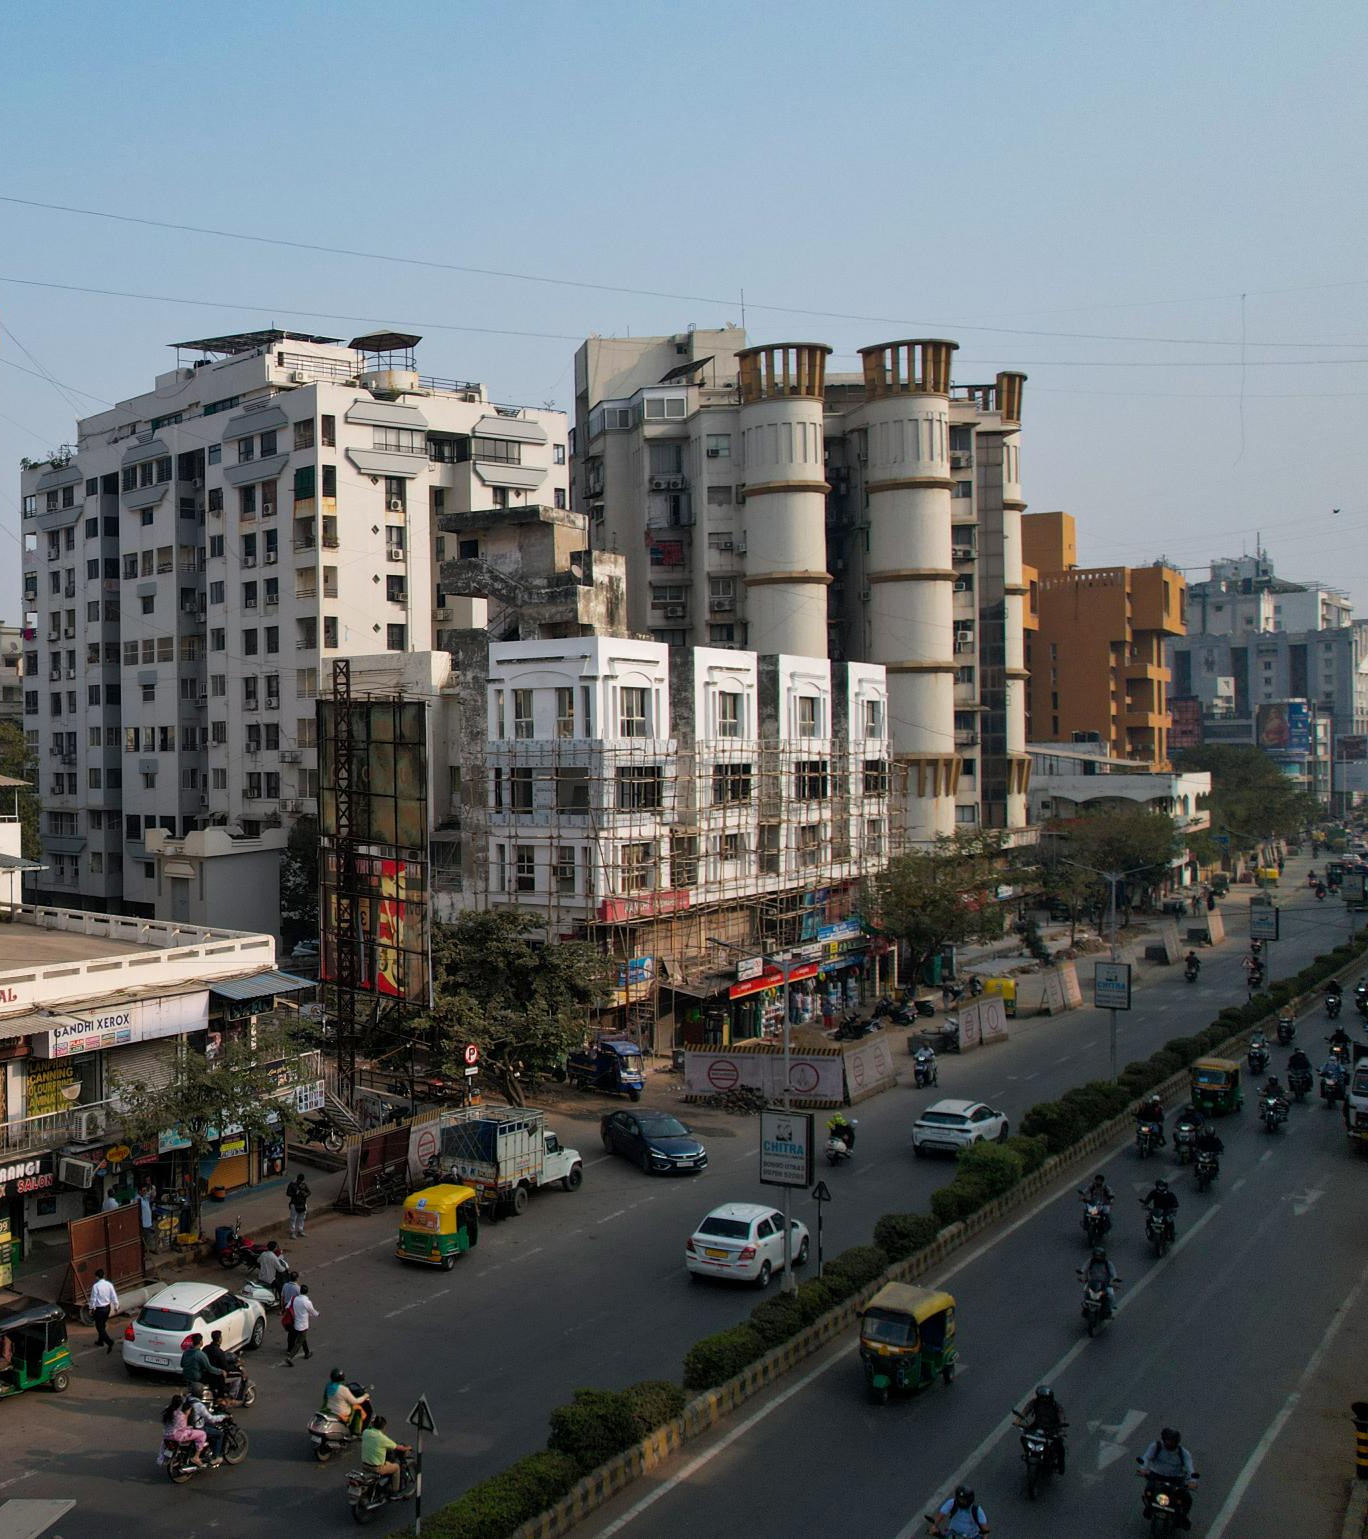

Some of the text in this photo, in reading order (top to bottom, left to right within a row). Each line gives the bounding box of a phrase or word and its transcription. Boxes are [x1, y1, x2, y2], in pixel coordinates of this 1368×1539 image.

[54, 1014, 130, 1038] GANDHI XEROX
[29, 1057, 73, 1073] LANPRINT
[764, 1140, 804, 1155] CHITRA
[17, 1173, 54, 1194] SALON
